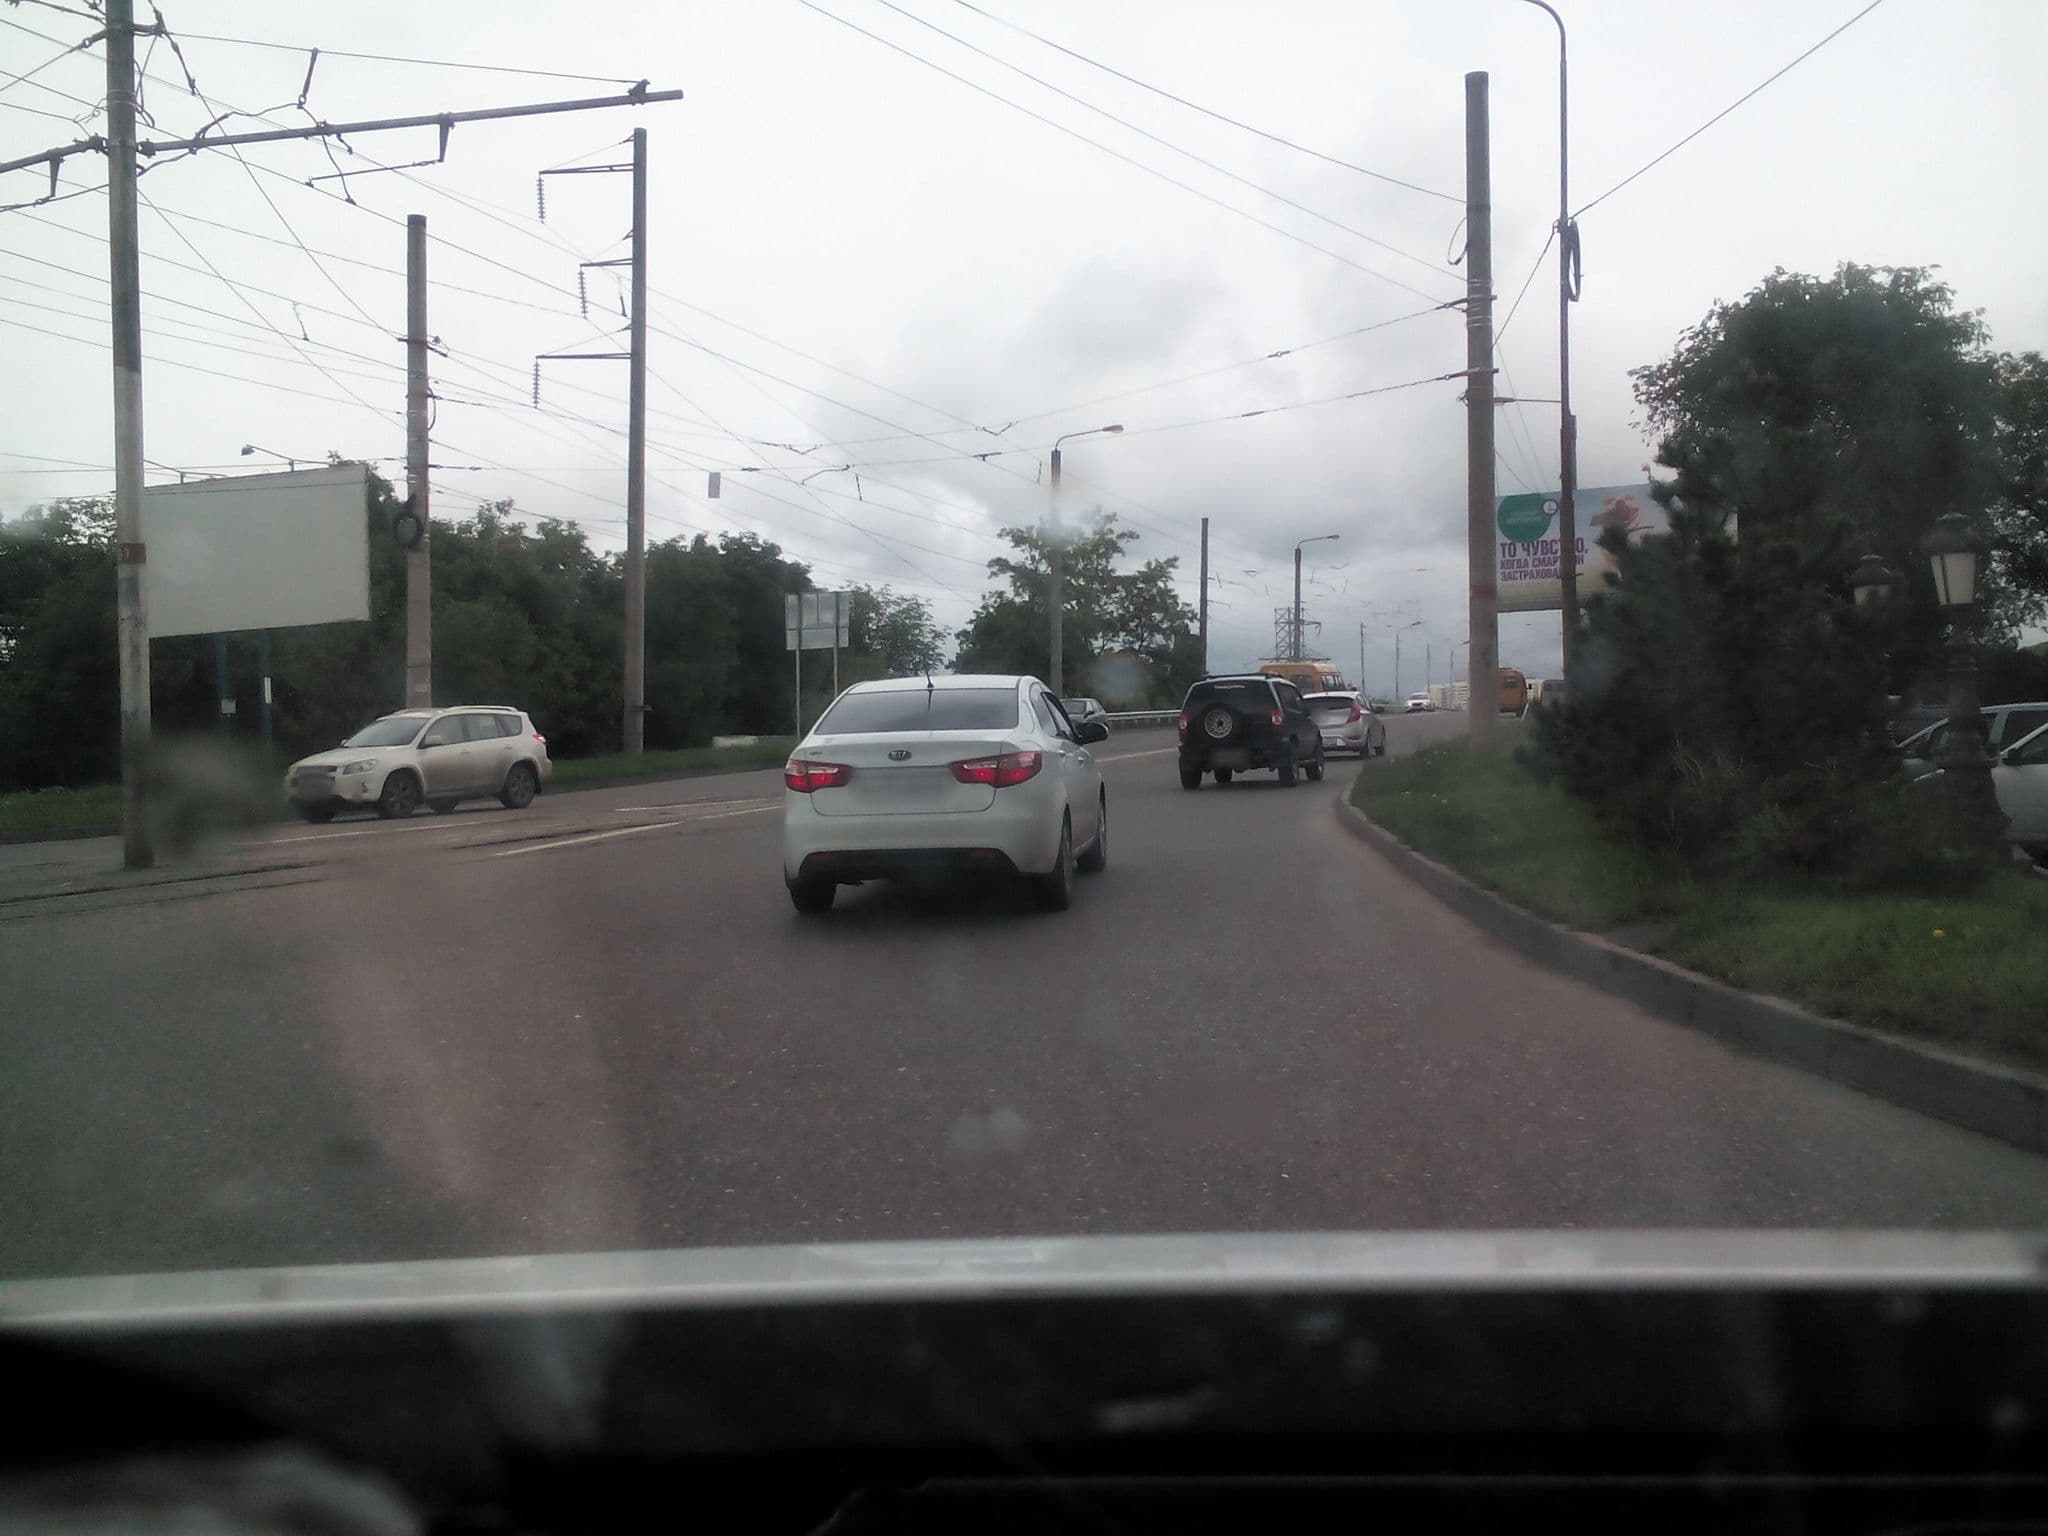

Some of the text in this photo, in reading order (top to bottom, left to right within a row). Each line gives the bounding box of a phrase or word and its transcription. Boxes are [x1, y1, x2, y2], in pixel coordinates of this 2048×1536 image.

[1500, 537, 1590, 558] ТО ЧУВСО,
[1500, 558, 1529, 570] КОГДА
